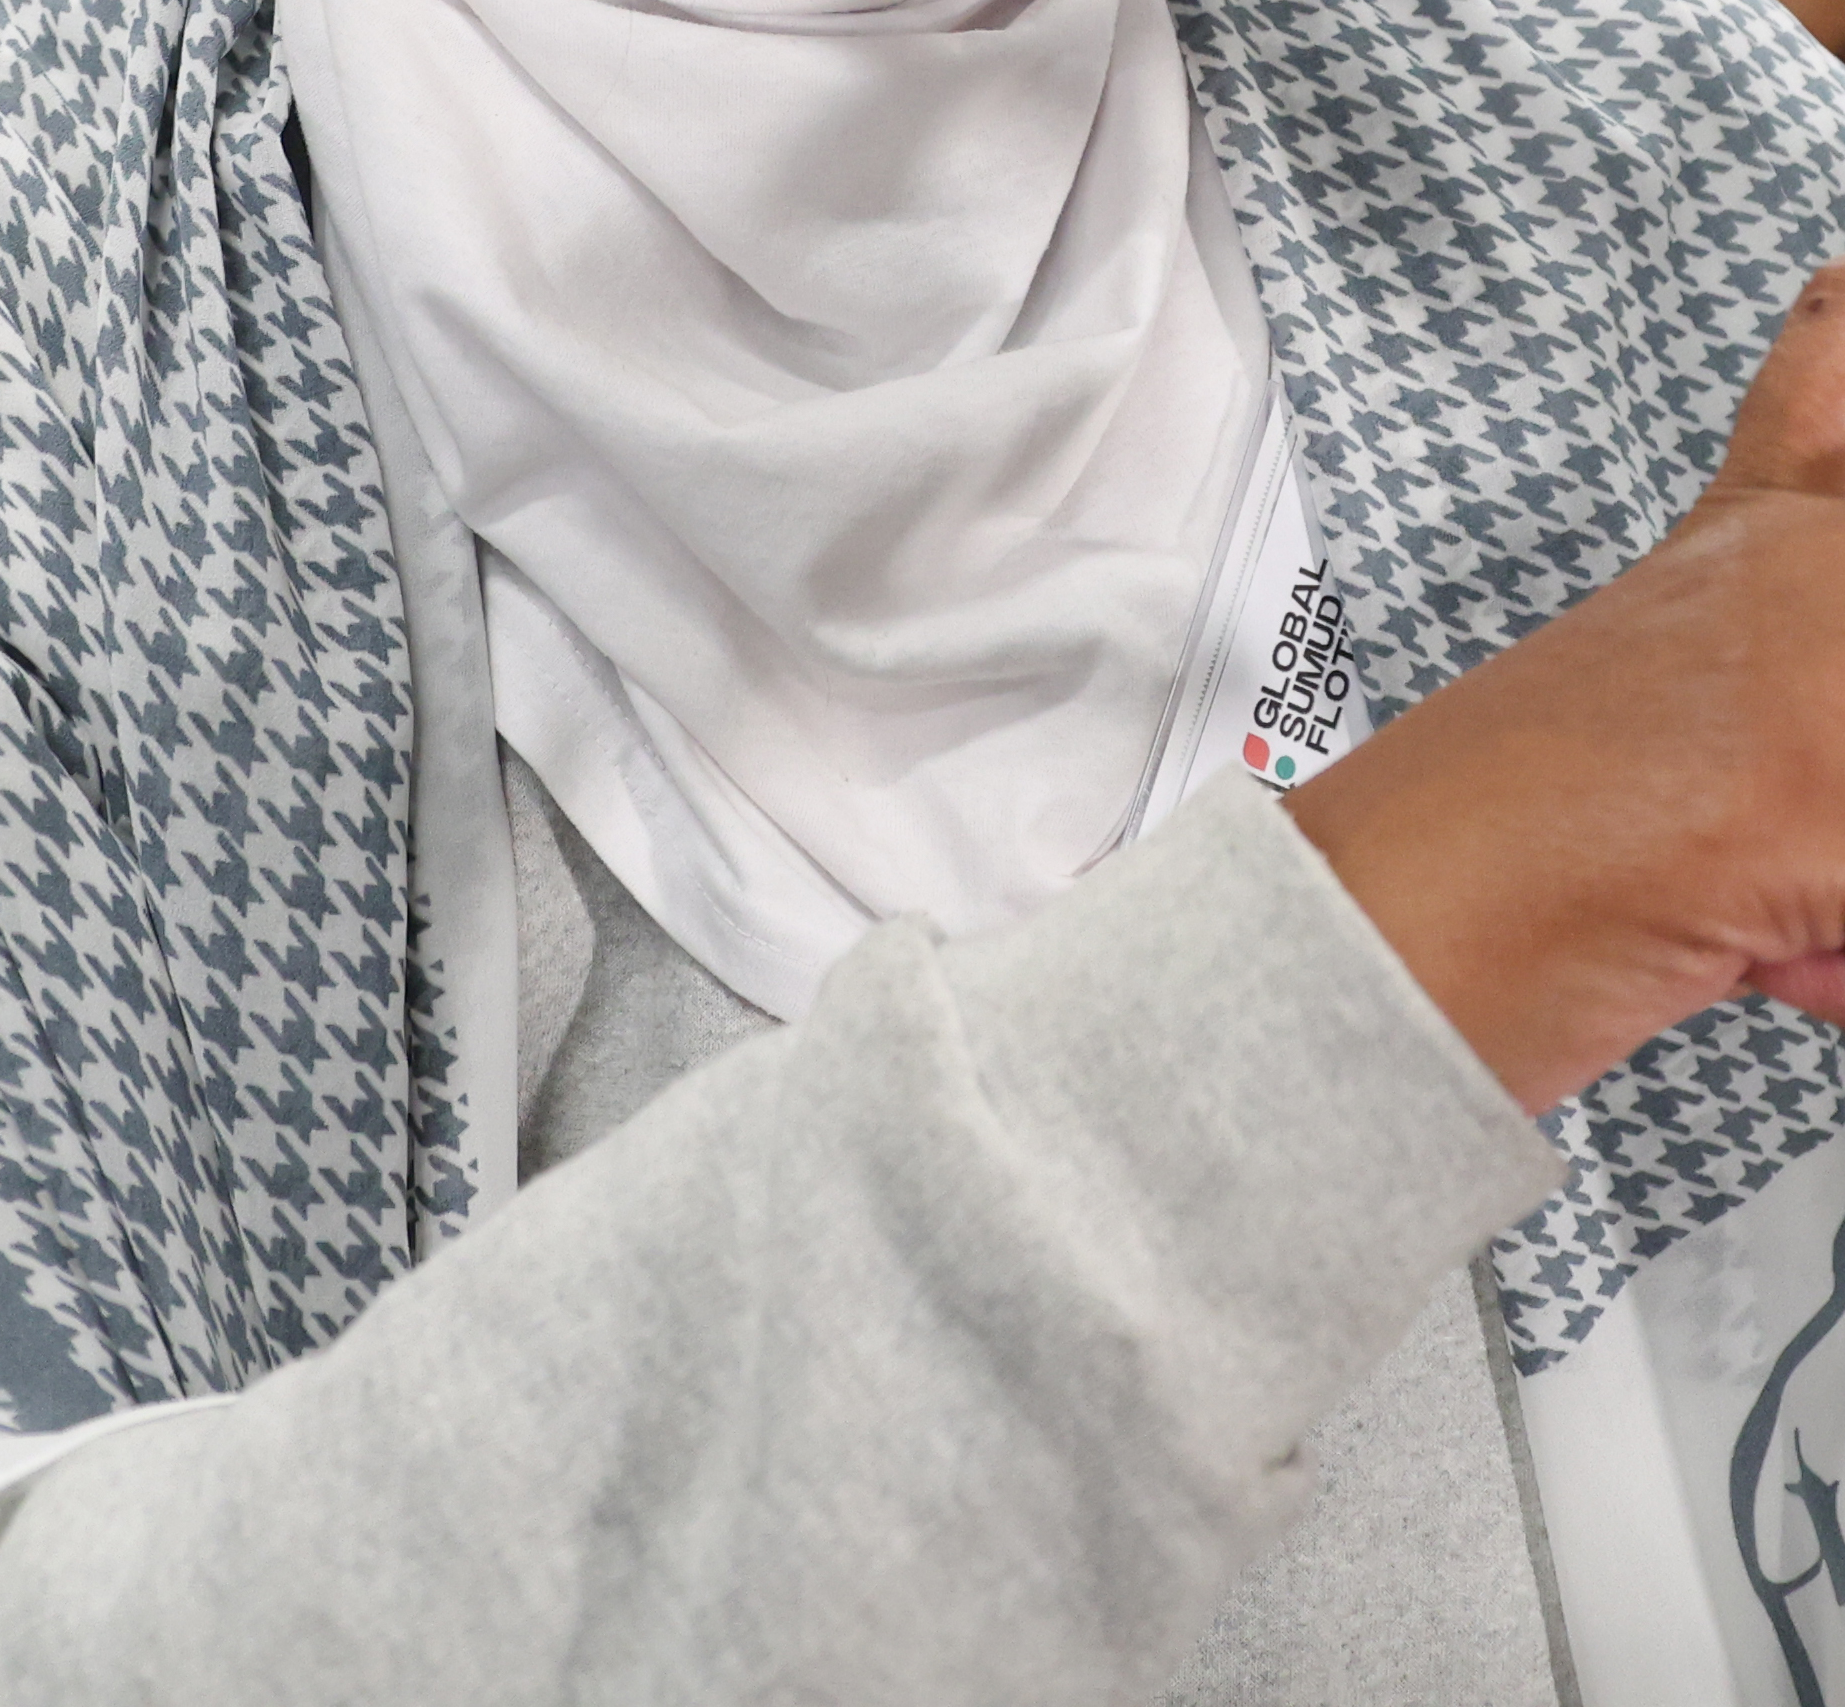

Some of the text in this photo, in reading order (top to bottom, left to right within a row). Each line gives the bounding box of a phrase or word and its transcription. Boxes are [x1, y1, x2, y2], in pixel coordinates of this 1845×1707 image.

[1253, 558, 1329, 730] GLOBAL
[1279, 594, 1343, 742] SUMUD
[1305, 618, 1355, 756] FLOT
